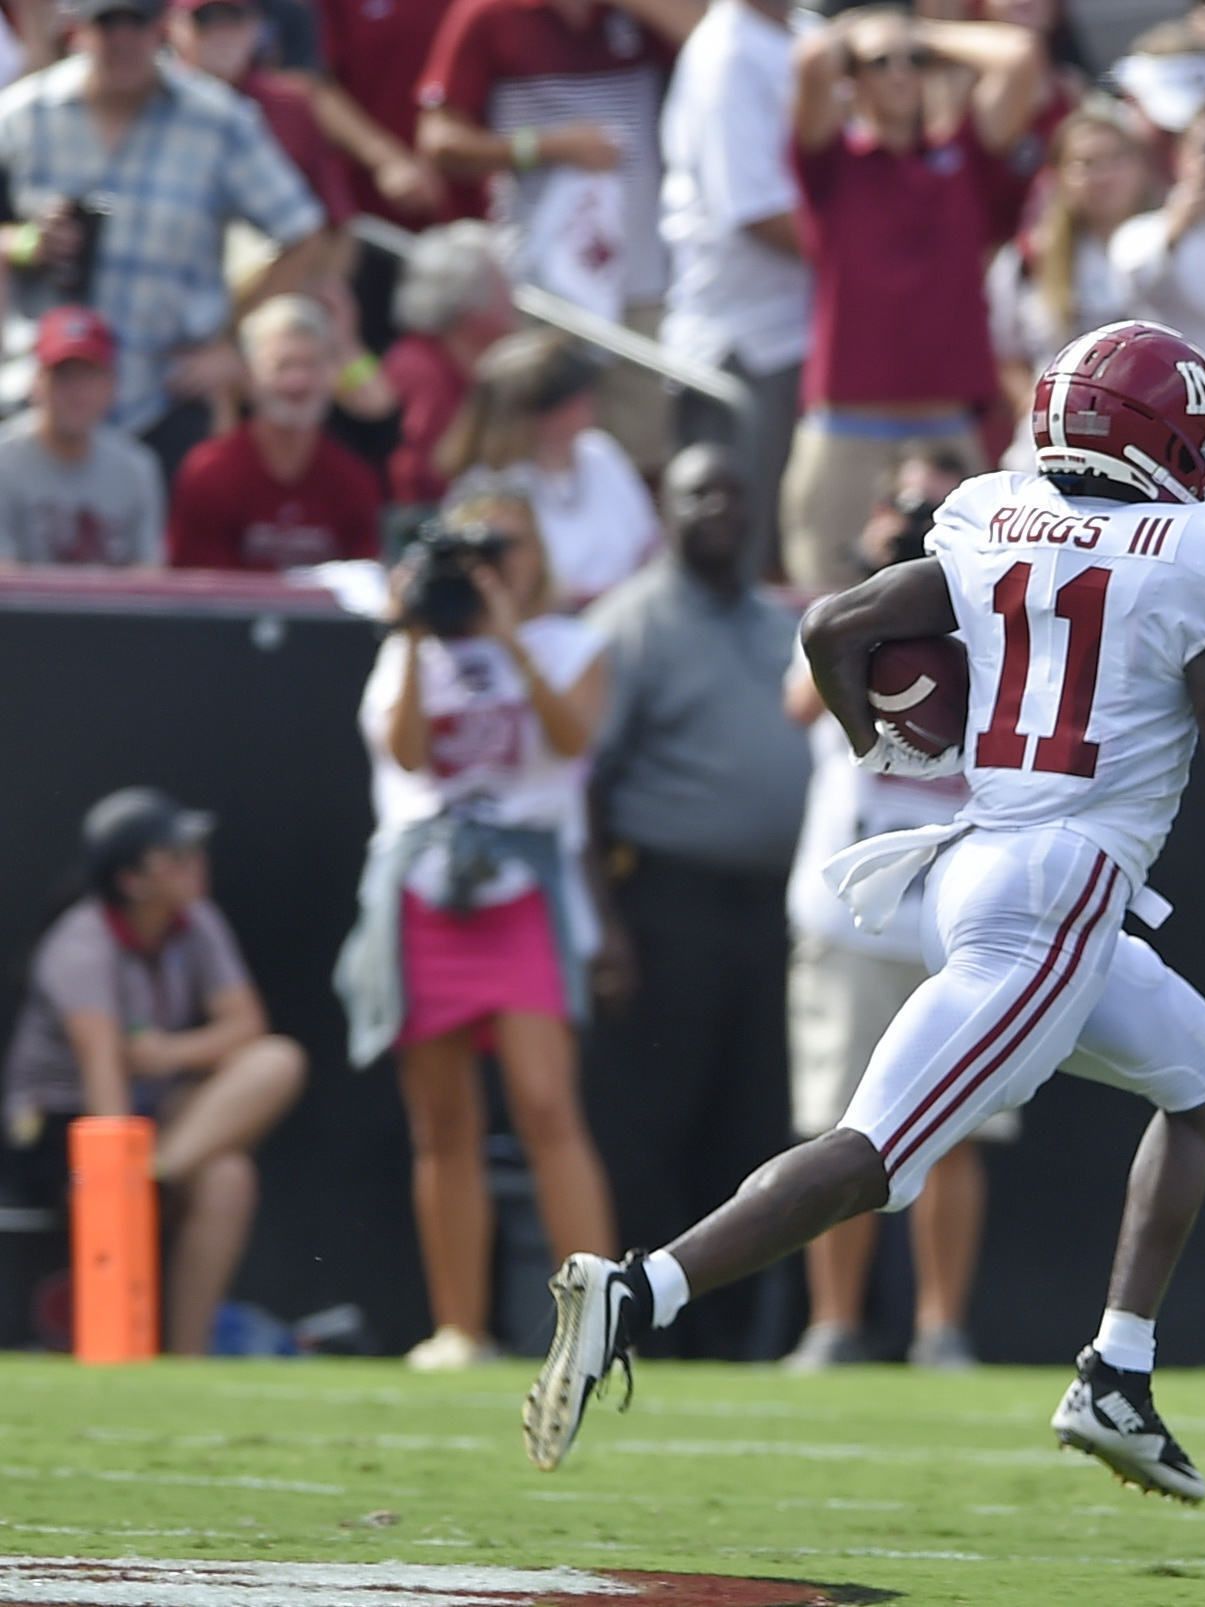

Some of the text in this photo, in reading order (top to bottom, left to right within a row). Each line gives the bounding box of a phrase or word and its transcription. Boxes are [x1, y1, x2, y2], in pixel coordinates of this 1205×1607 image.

[989, 506, 1174, 556] RUGGS III
[975, 561, 1112, 779] 11
